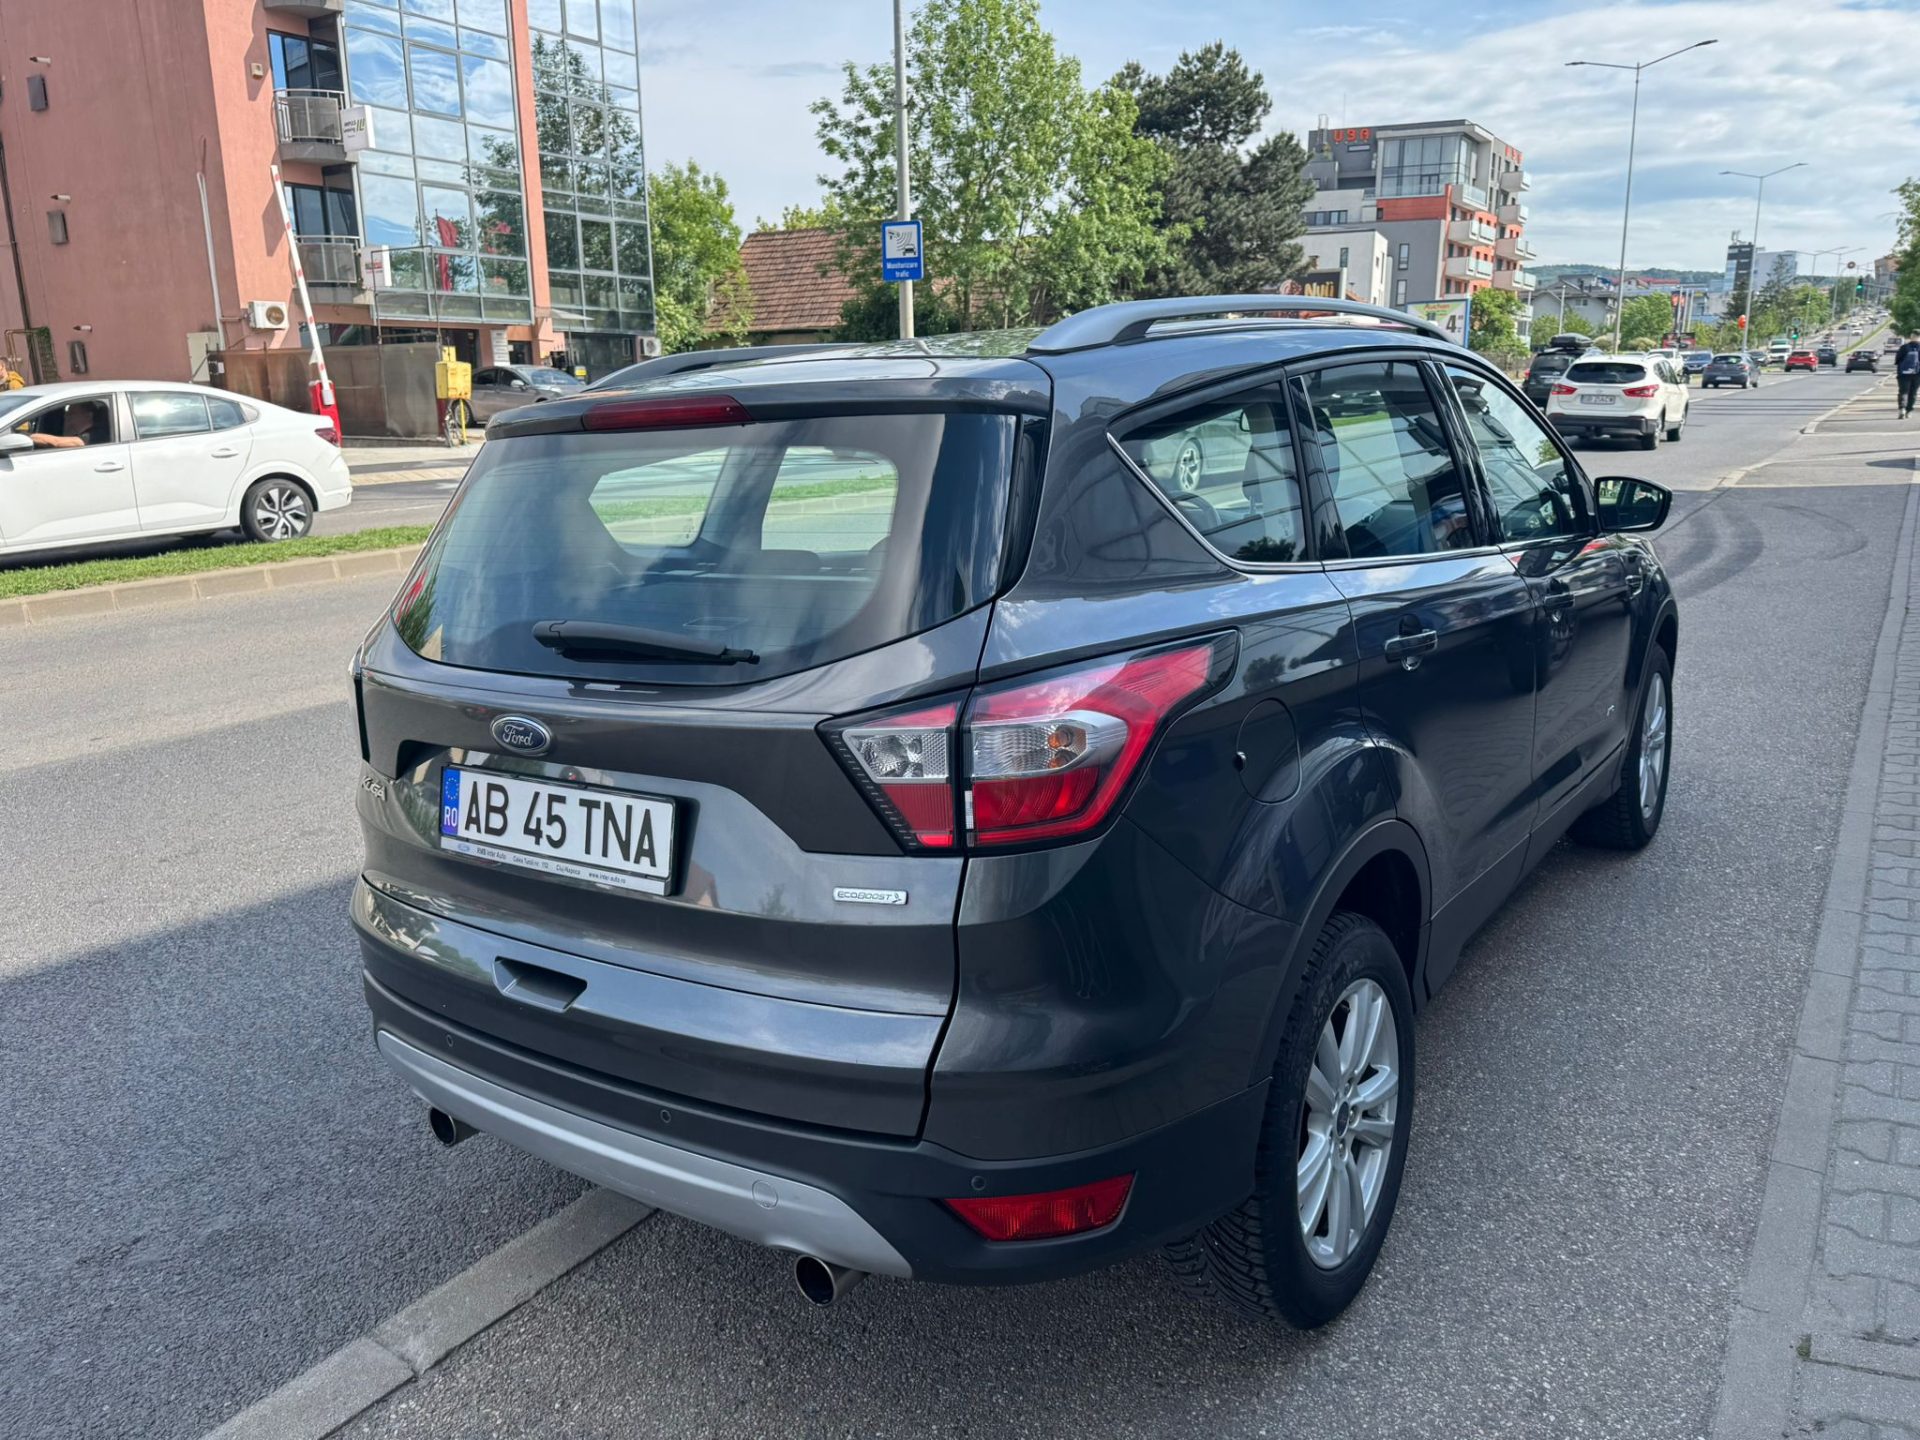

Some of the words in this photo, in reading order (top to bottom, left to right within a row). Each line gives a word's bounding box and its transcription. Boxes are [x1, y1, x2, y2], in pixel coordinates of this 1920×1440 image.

[1446, 314, 1457, 333] 4
[503, 724, 534, 746] Ford
[444, 806, 457, 827] RO
[465, 781, 509, 837] AB
[523, 791, 567, 849] 45
[579, 798, 657, 867] TNA
[837, 890, 892, 900] ECOBOOST
